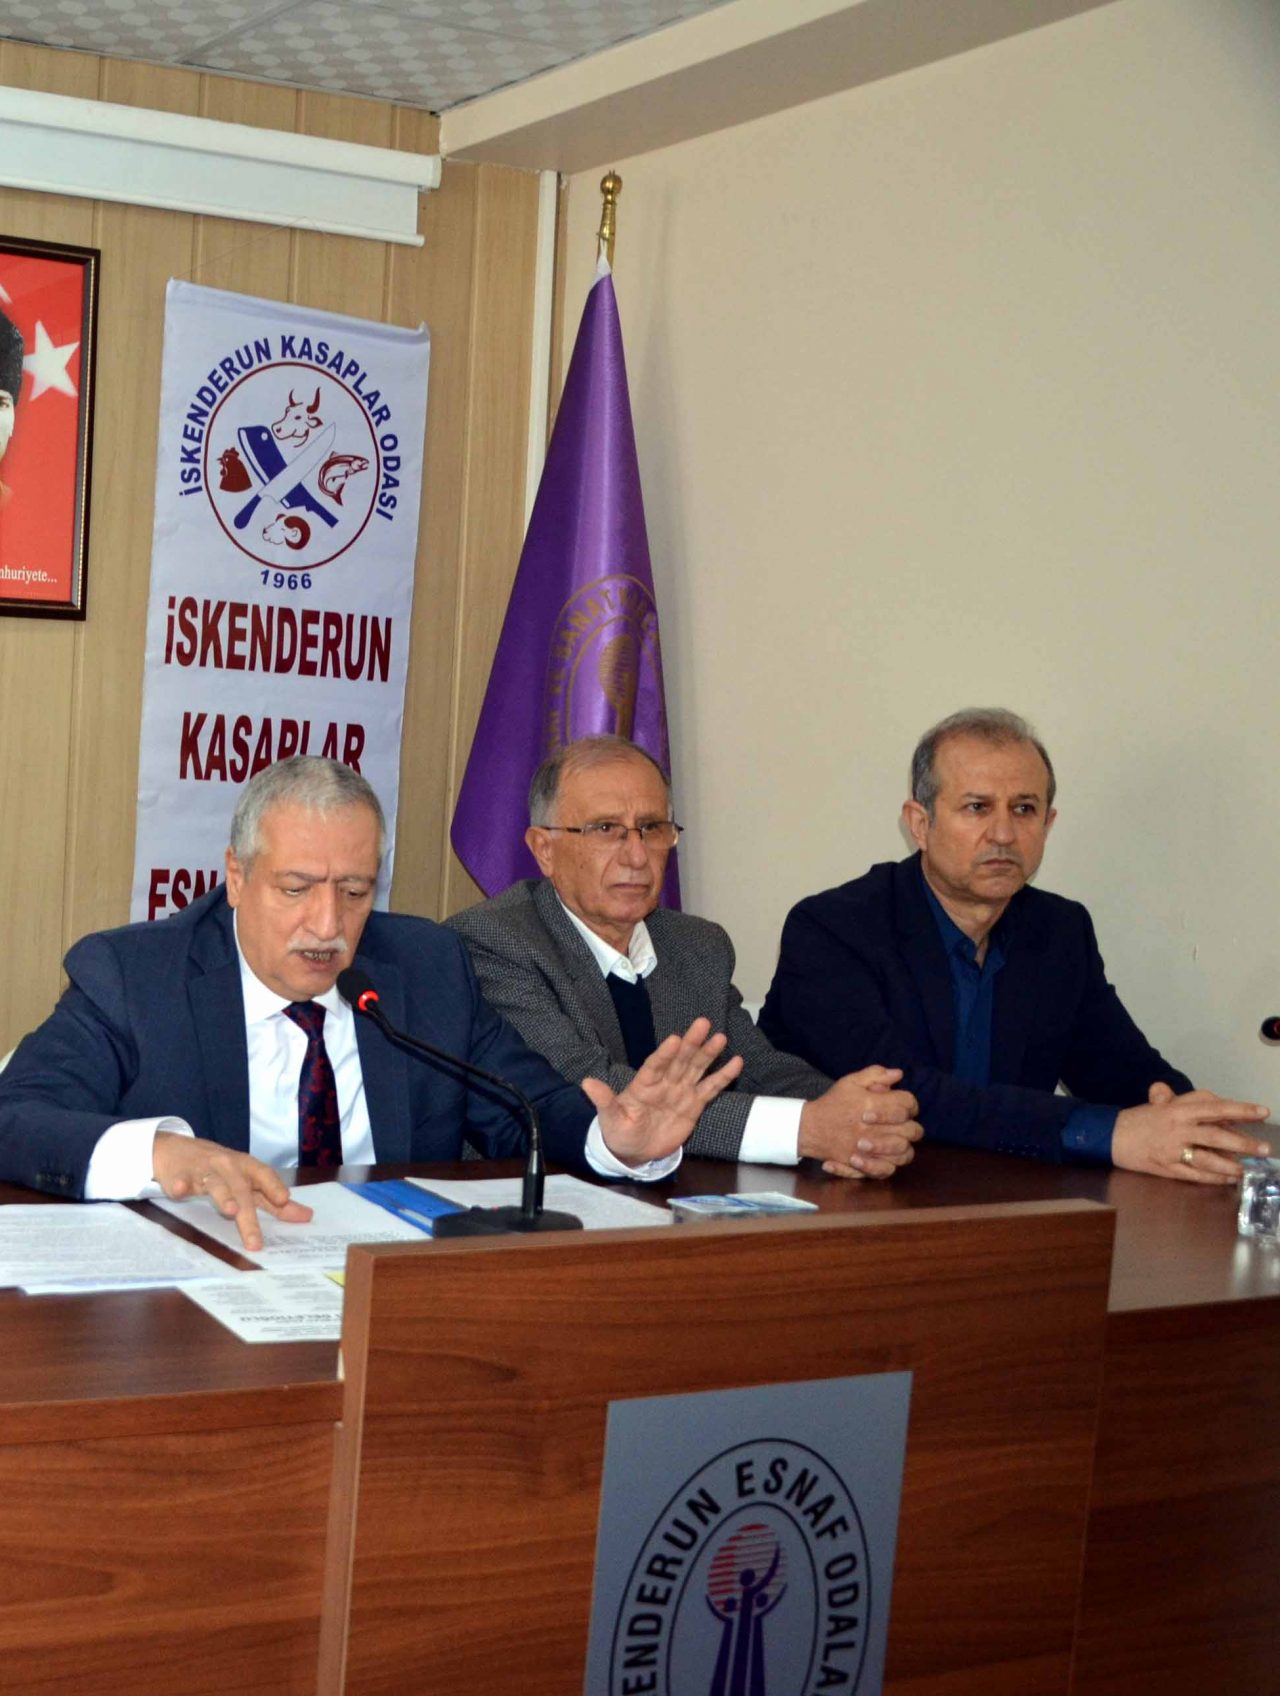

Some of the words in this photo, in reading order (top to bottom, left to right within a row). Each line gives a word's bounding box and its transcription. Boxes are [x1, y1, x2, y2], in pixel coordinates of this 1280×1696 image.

[281, 335, 392, 427] KASAPLAR
[375, 433, 401, 521] ODASI
[260, 569, 312, 590] 1966
[735, 1457, 850, 1541] ESNAF
[812, 1552, 860, 1696] ODALA
